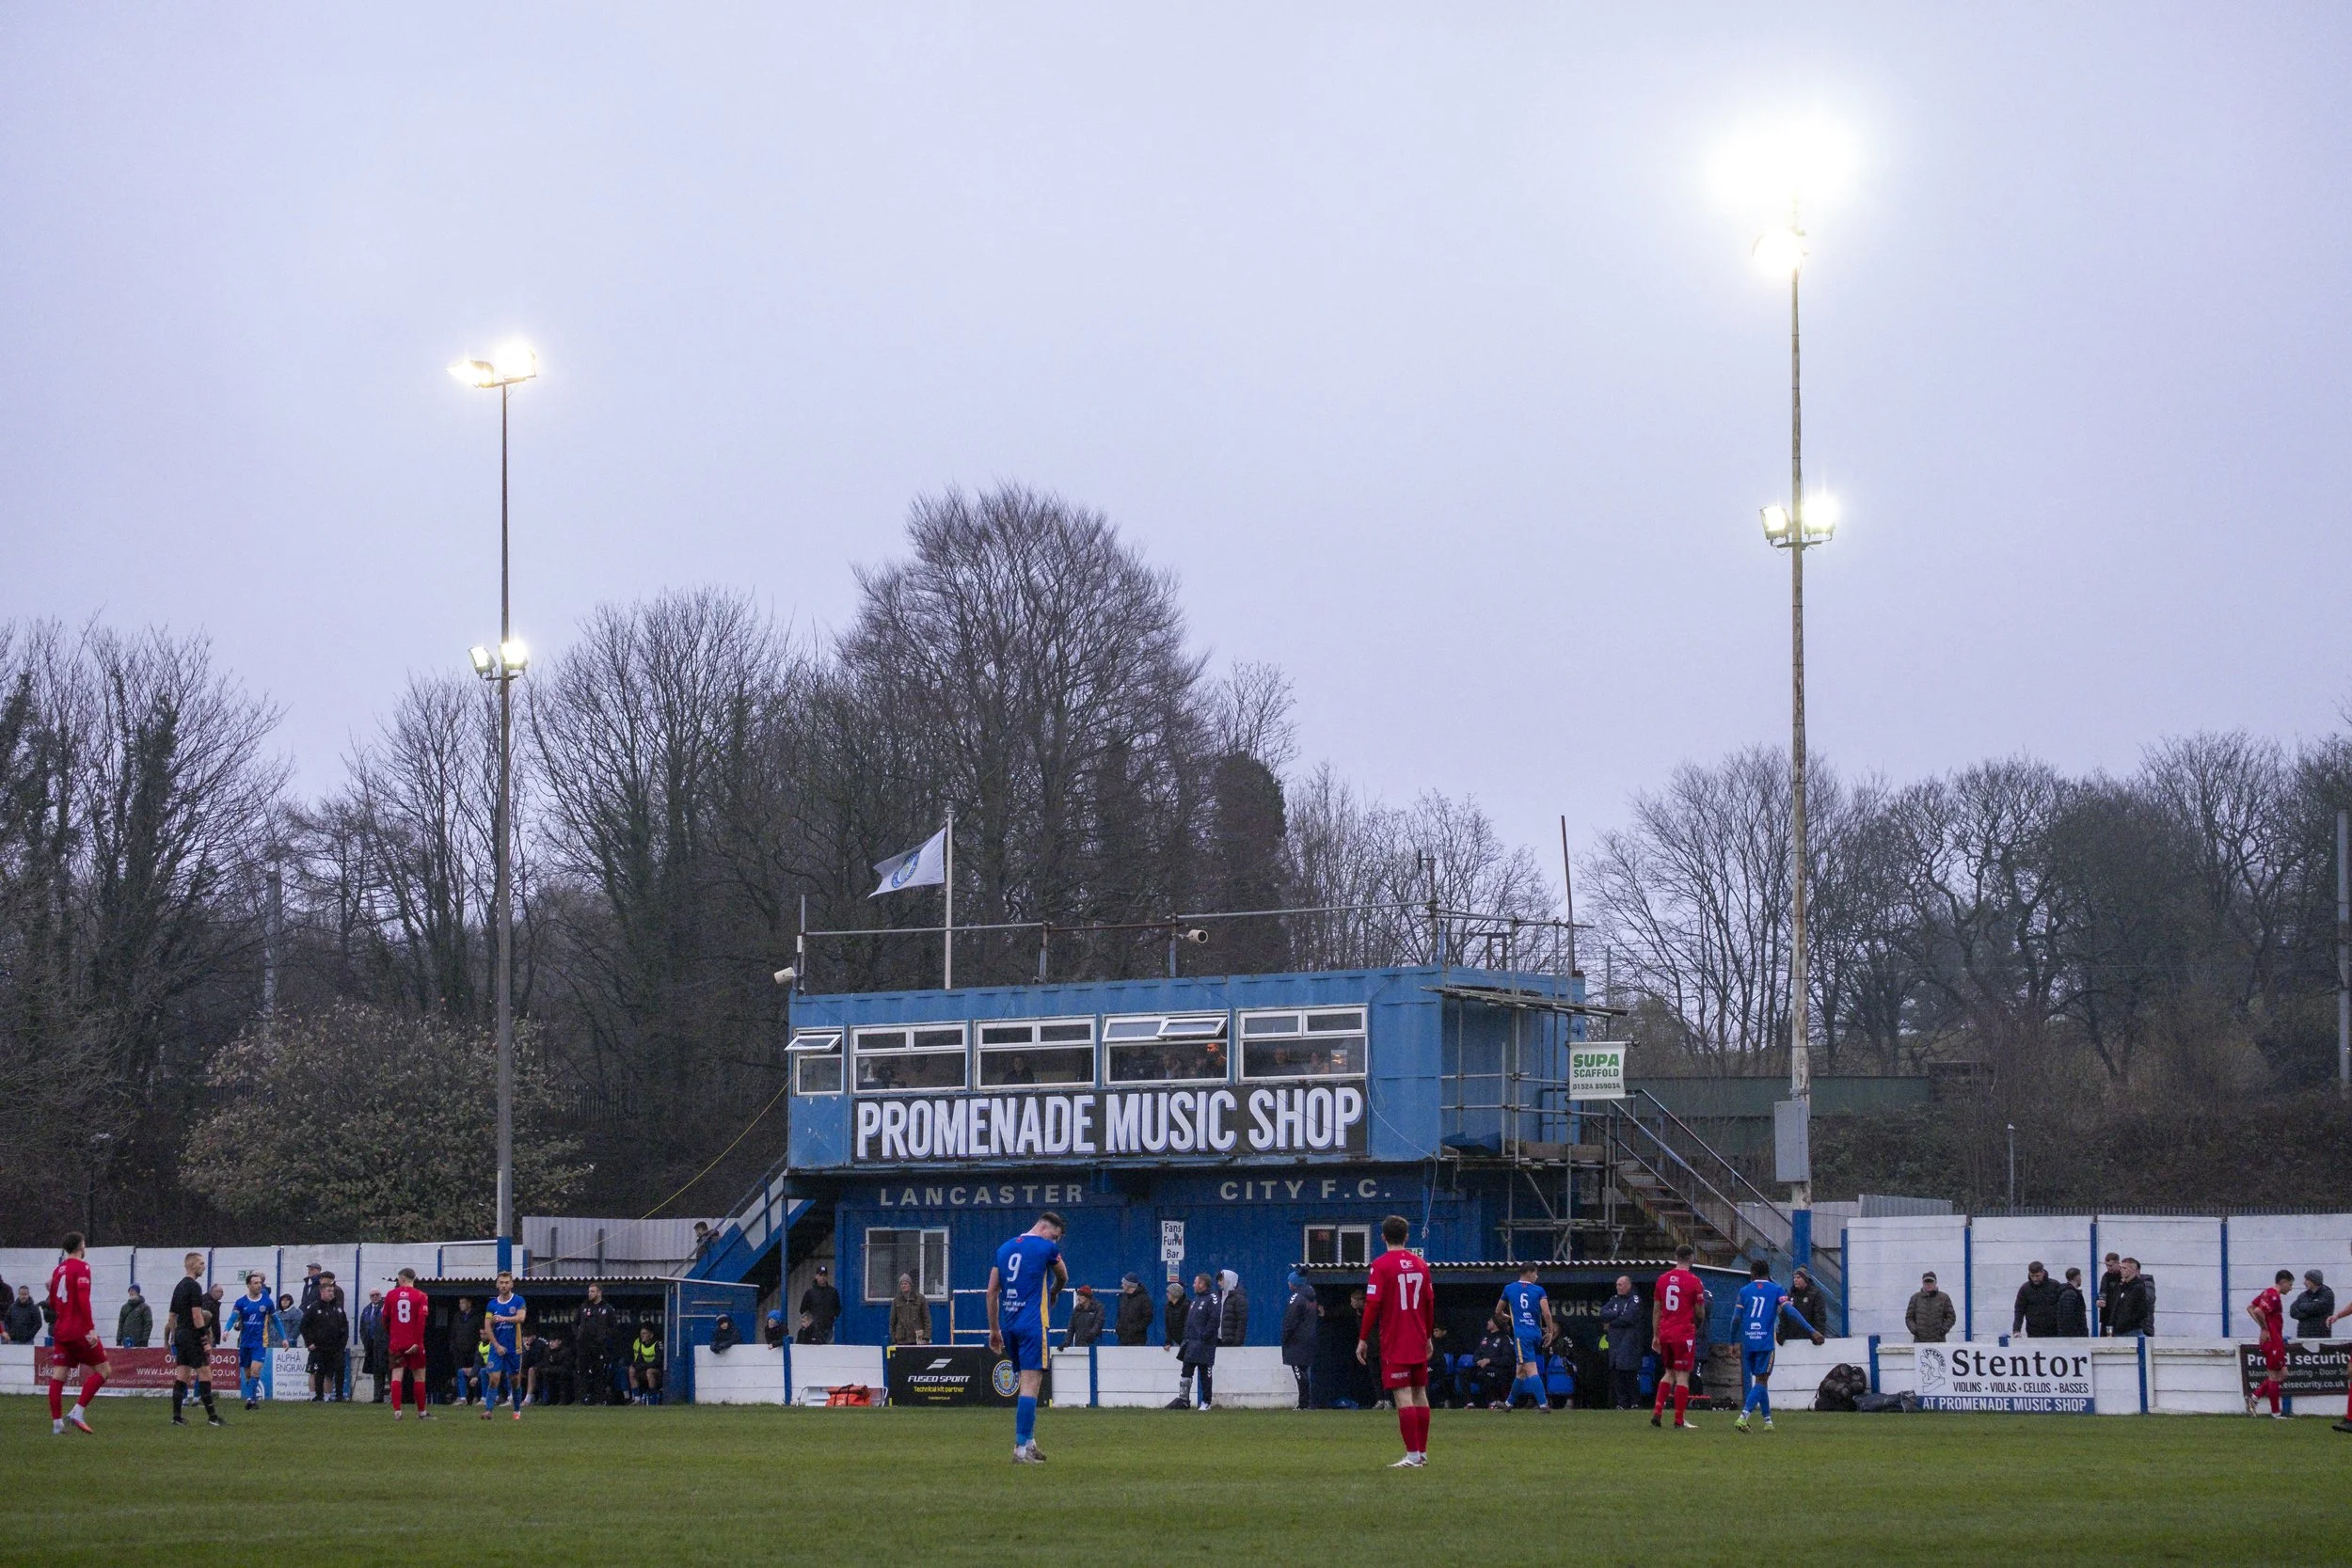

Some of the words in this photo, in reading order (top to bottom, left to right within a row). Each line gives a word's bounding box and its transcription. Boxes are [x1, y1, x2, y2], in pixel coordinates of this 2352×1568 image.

[1573, 1053, 1619, 1068] SUPA
[1573, 1069, 1619, 1078] SCAFFOLD
[857, 1095, 1096, 1159] PROMENADE
[1105, 1090, 1237, 1152] MUSIC
[1248, 1087, 1363, 1151] SHOP
[881, 1184, 1083, 1206] LANCASTER
[1220, 1180, 1304, 1200] CITY
[1322, 1179, 1391, 1198] F.C.
[1165, 1223, 1182, 1233] Fans
[1167, 1249, 1180, 1259] Bar
[1007, 1253, 1022, 1282] 9
[56, 1274, 68, 1304] 4
[1397, 1273, 1423, 1310] 17
[1665, 1285, 1680, 1311] 6
[1519, 1292, 1529, 1309] 6
[1550, 1301, 1601, 1316] TORS
[1750, 1296, 1766, 1318] 11
[397, 1299, 411, 1323] 8
[640, 1309, 664, 1323] CIT
[1952, 1349, 2088, 1377] Stentor
[1953, 1382, 1981, 1393] VIOLINS
[1990, 1382, 2017, 1393] VIOLAS
[2024, 1382, 2051, 1393] CELLOS
[2059, 1383, 2089, 1394] BASSES
[1922, 1398, 1936, 1410] AT
[1939, 1398, 2010, 1411] PROMENADE
[2013, 1398, 2052, 1412] MUSIC
[2055, 1398, 2087, 1412] SHOP
